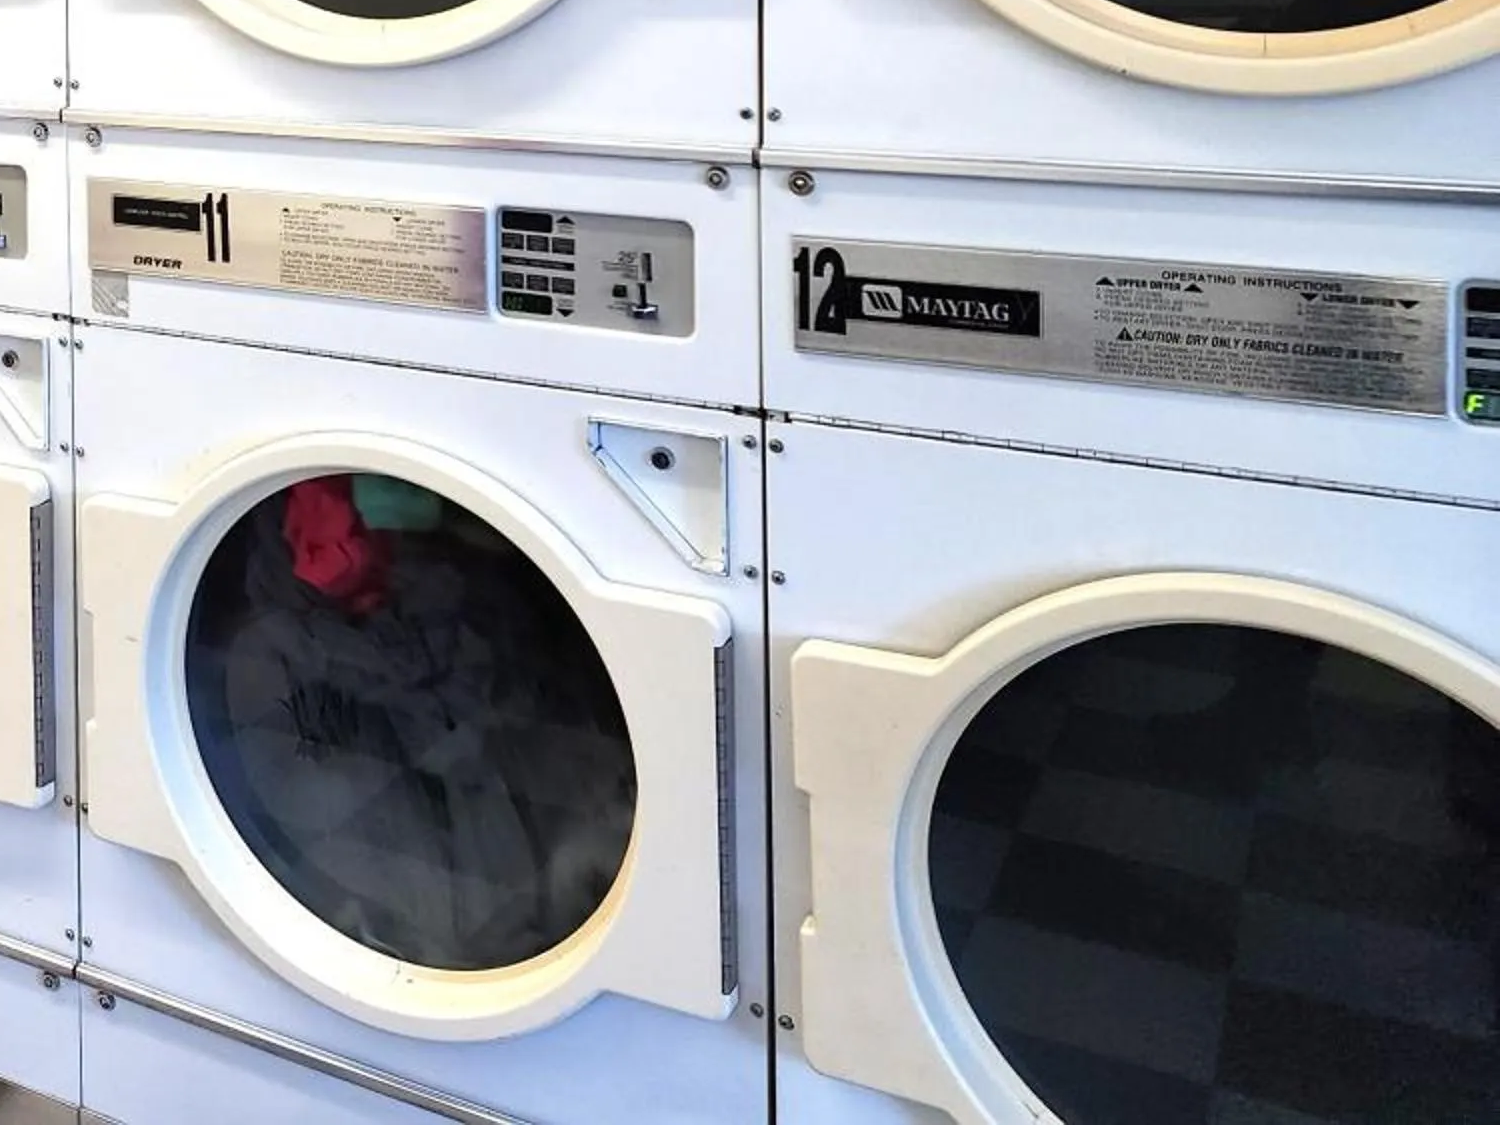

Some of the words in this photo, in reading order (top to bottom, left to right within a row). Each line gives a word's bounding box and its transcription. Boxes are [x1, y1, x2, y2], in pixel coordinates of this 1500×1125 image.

[201, 192, 231, 263] 11
[133, 255, 182, 270] DRYER
[793, 246, 847, 335] 12
[1116, 278, 1147, 288] UPPER
[1150, 280, 1181, 292] DRYER
[1161, 270, 1237, 285] OPERATING
[1243, 276, 1343, 293] INSTRUCTIONS
[906, 295, 1010, 322] MAYTAG
[1322, 293, 1358, 304] LOWER
[1134, 329, 1183, 345] CAUTION:
[1185, 333, 1209, 347] DRY
[1211, 335, 1240, 350] ONLY
[1243, 339, 1289, 354] FABRICS
[1292, 342, 1344, 358] CLEANED
[1466, 393, 1485, 413] F
